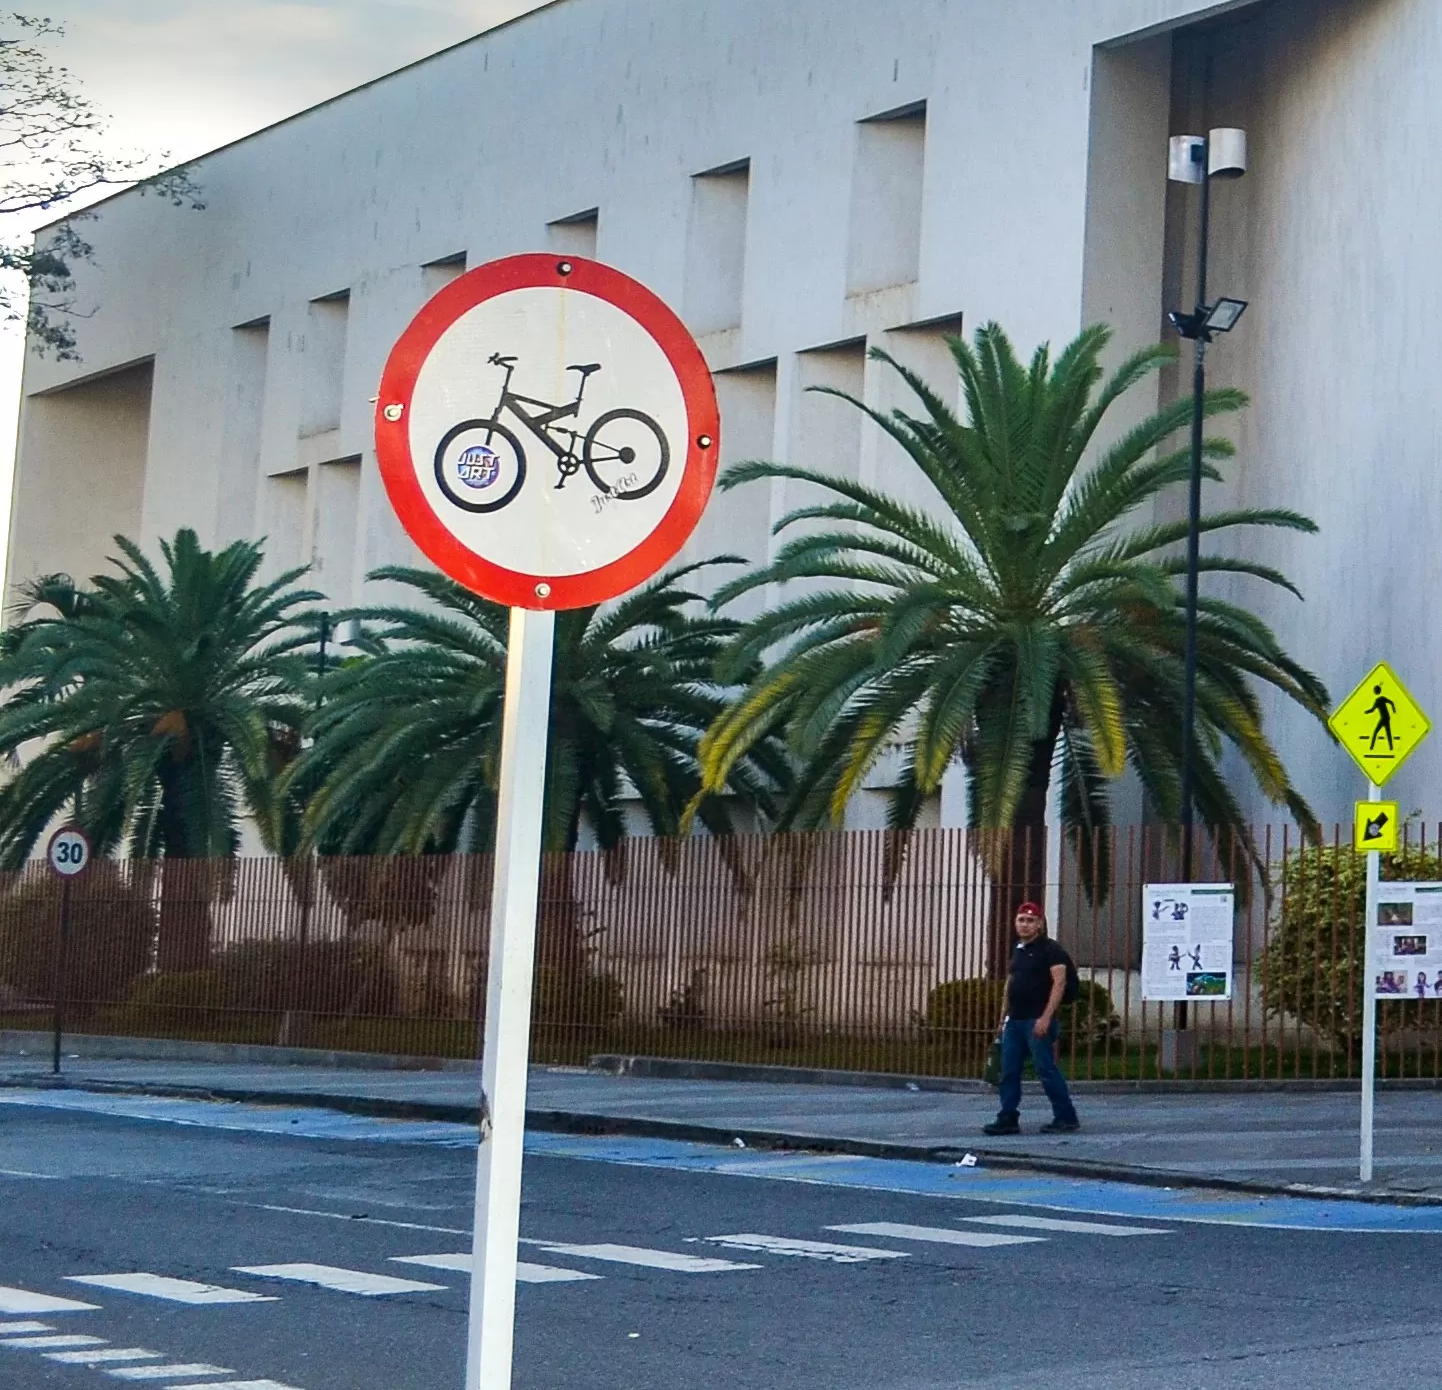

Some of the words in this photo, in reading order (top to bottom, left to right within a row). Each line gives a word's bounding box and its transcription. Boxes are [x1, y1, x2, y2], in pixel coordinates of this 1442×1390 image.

[458, 452, 500, 466] JUST
[457, 465, 496, 479] ART
[57, 842, 84, 864] 30
